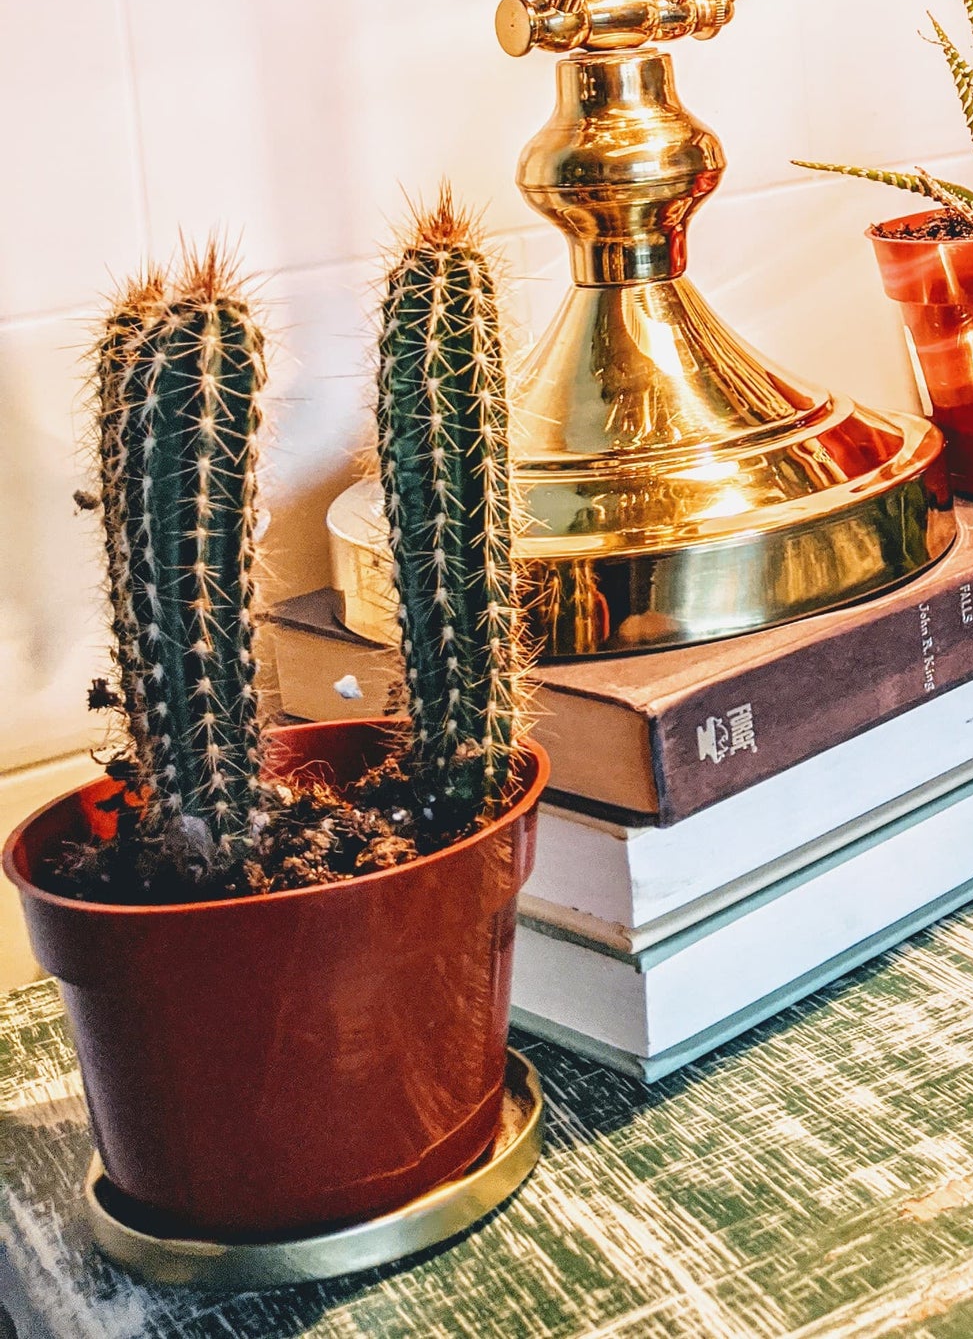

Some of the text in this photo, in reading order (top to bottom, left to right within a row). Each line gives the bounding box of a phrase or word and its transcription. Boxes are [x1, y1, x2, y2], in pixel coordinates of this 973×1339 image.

[958, 583, 973, 625] FALLS
[918, 603, 937, 693] John R. King
[727, 702, 757, 756] FORGE
